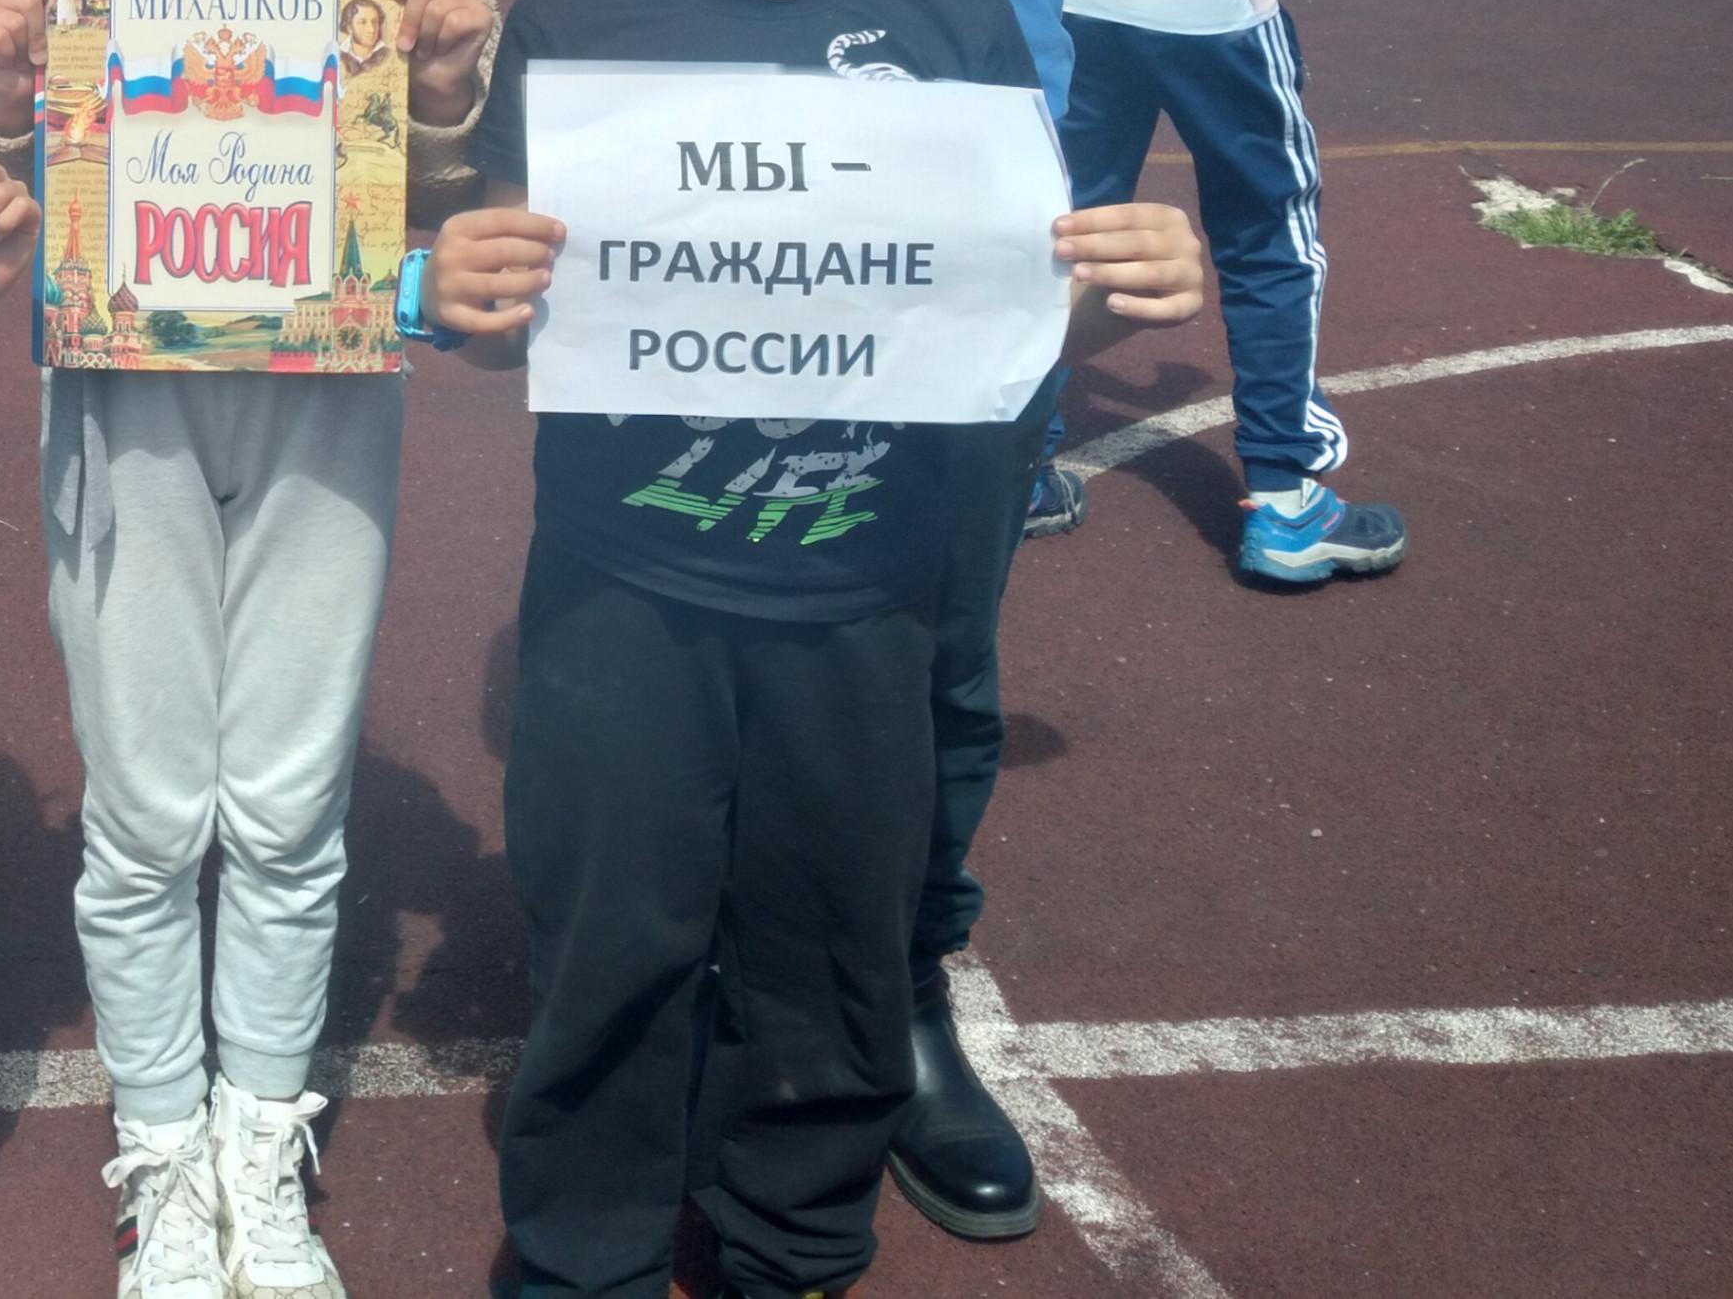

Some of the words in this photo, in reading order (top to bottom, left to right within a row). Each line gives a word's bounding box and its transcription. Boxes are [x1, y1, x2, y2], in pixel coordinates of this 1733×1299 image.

[126, 128, 200, 185] Моя
[209, 130, 315, 203] Родина
[676, 141, 809, 192] МЫ
[133, 199, 313, 289] РОССИЯ
[599, 240, 935, 295] ГРАЖДАНЕ
[629, 328, 876, 377] РОССИИ
